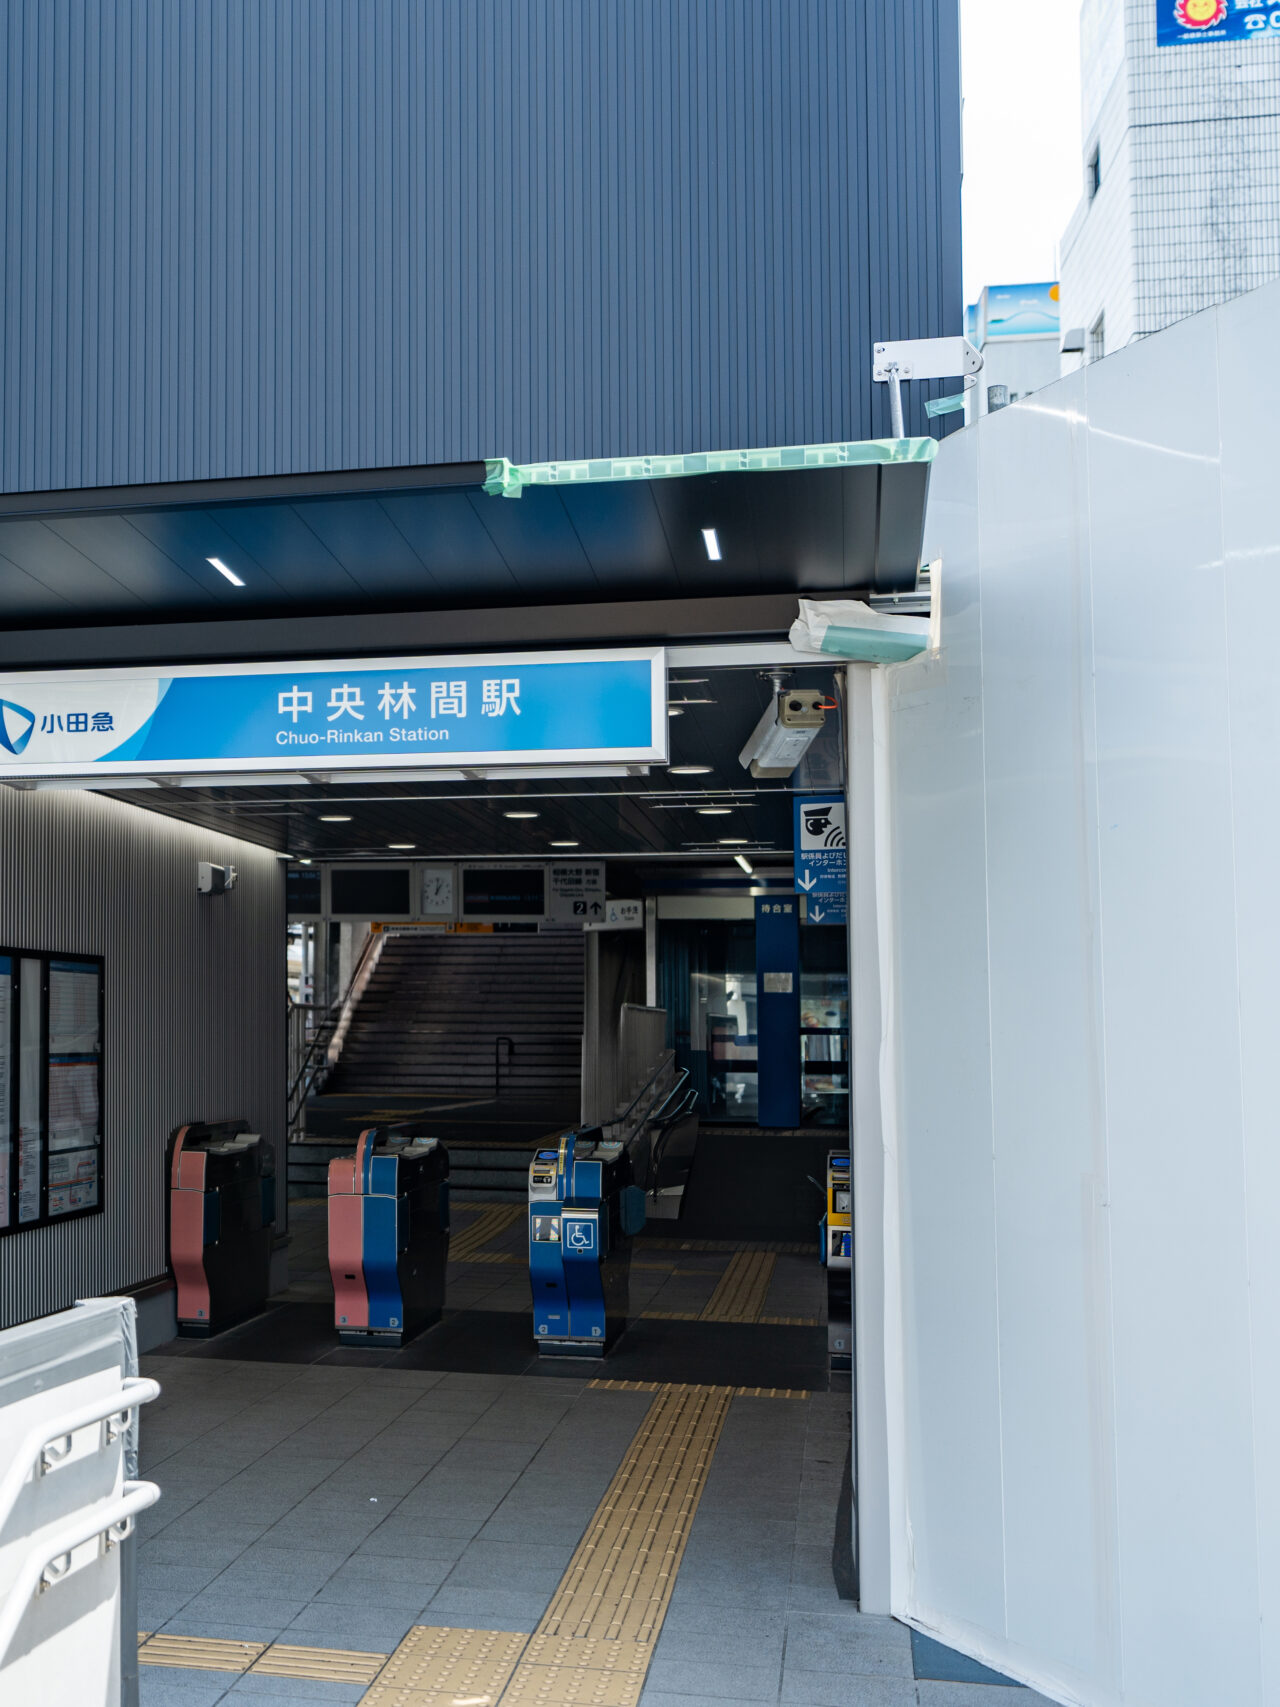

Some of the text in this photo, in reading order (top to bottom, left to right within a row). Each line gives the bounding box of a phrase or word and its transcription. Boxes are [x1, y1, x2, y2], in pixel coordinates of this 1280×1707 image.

[277, 679, 522, 723] 中央林間駅
[40, 711, 115, 734] 小田急
[275, 727, 449, 745] Chuo-Rinkan Station
[575, 902, 585, 914] 2
[761, 903, 793, 914] 待合室
